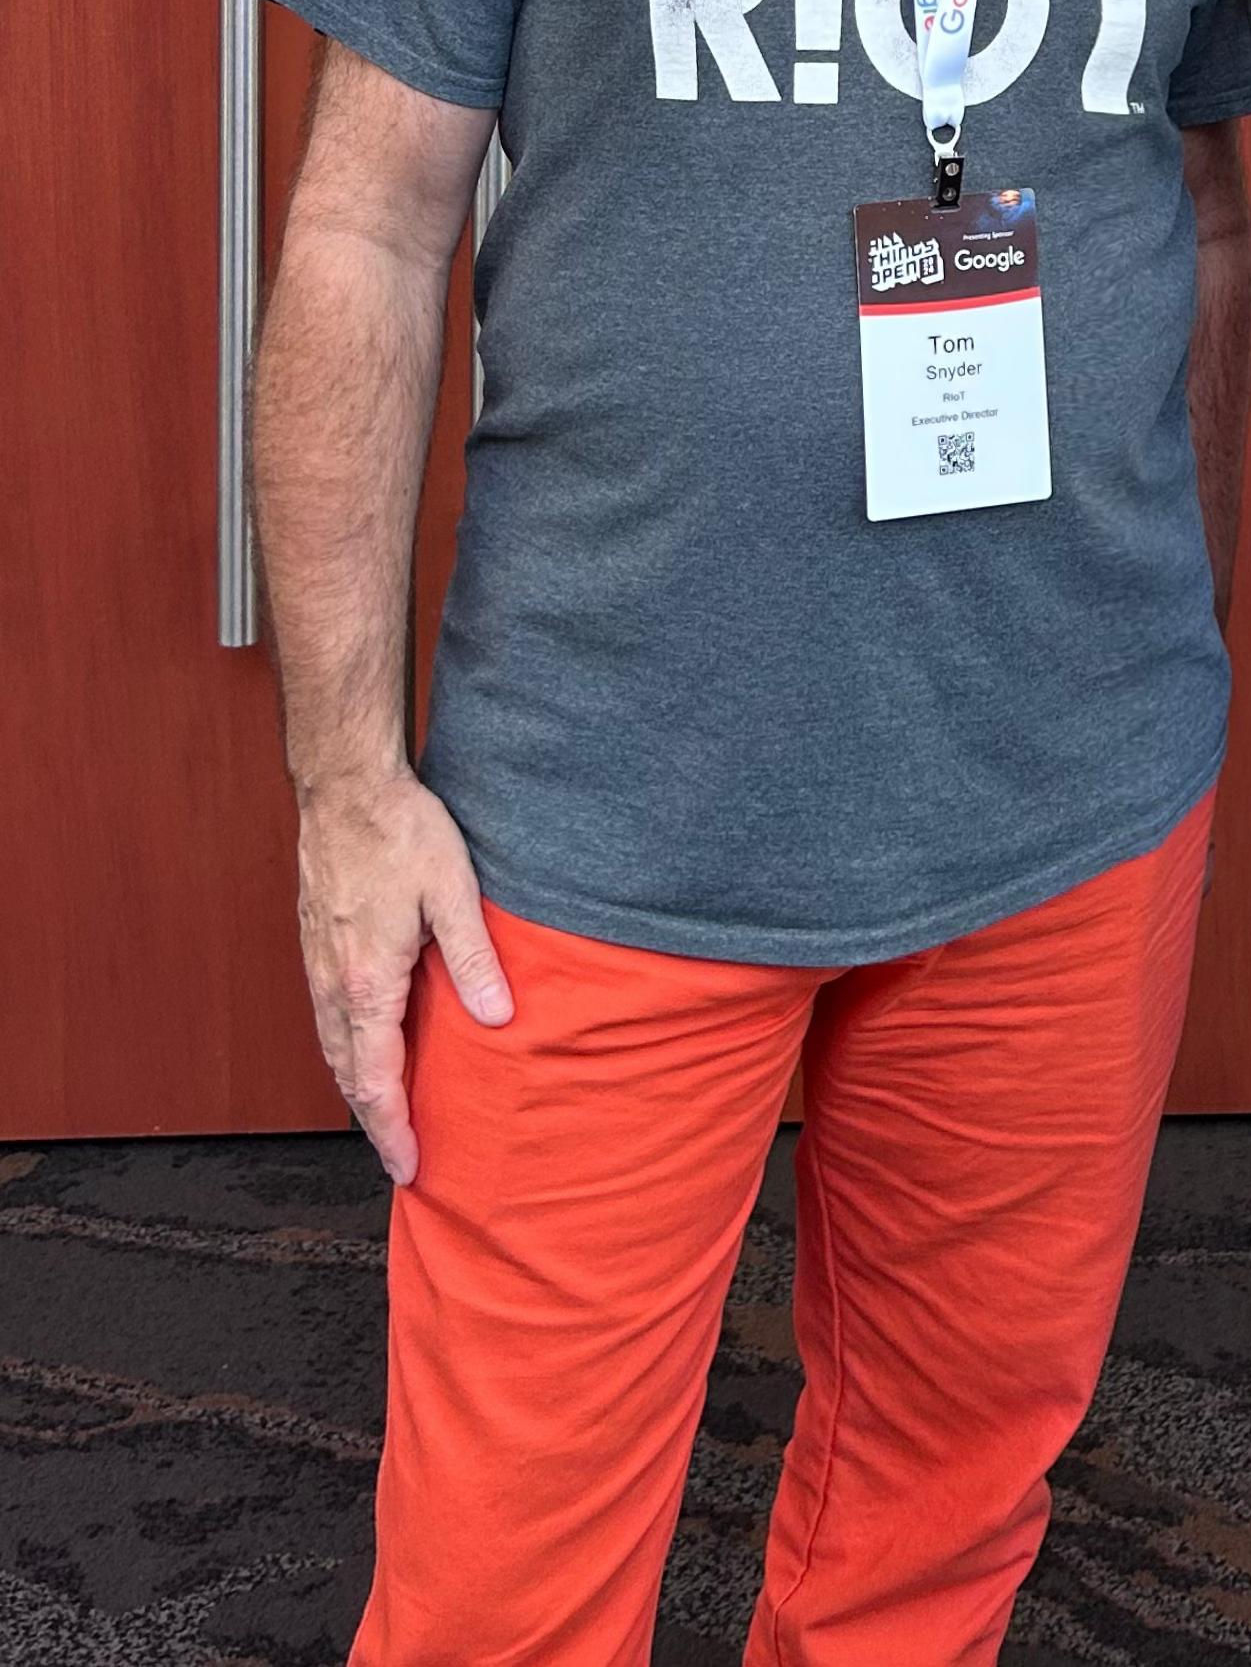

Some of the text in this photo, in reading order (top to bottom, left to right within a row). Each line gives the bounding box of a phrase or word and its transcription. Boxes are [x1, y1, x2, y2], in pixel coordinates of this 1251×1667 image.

[954, 245, 1026, 272] Google
[927, 335, 975, 355] Tom
[926, 361, 983, 382] Snyder
[911, 408, 999, 426] Executive Director
